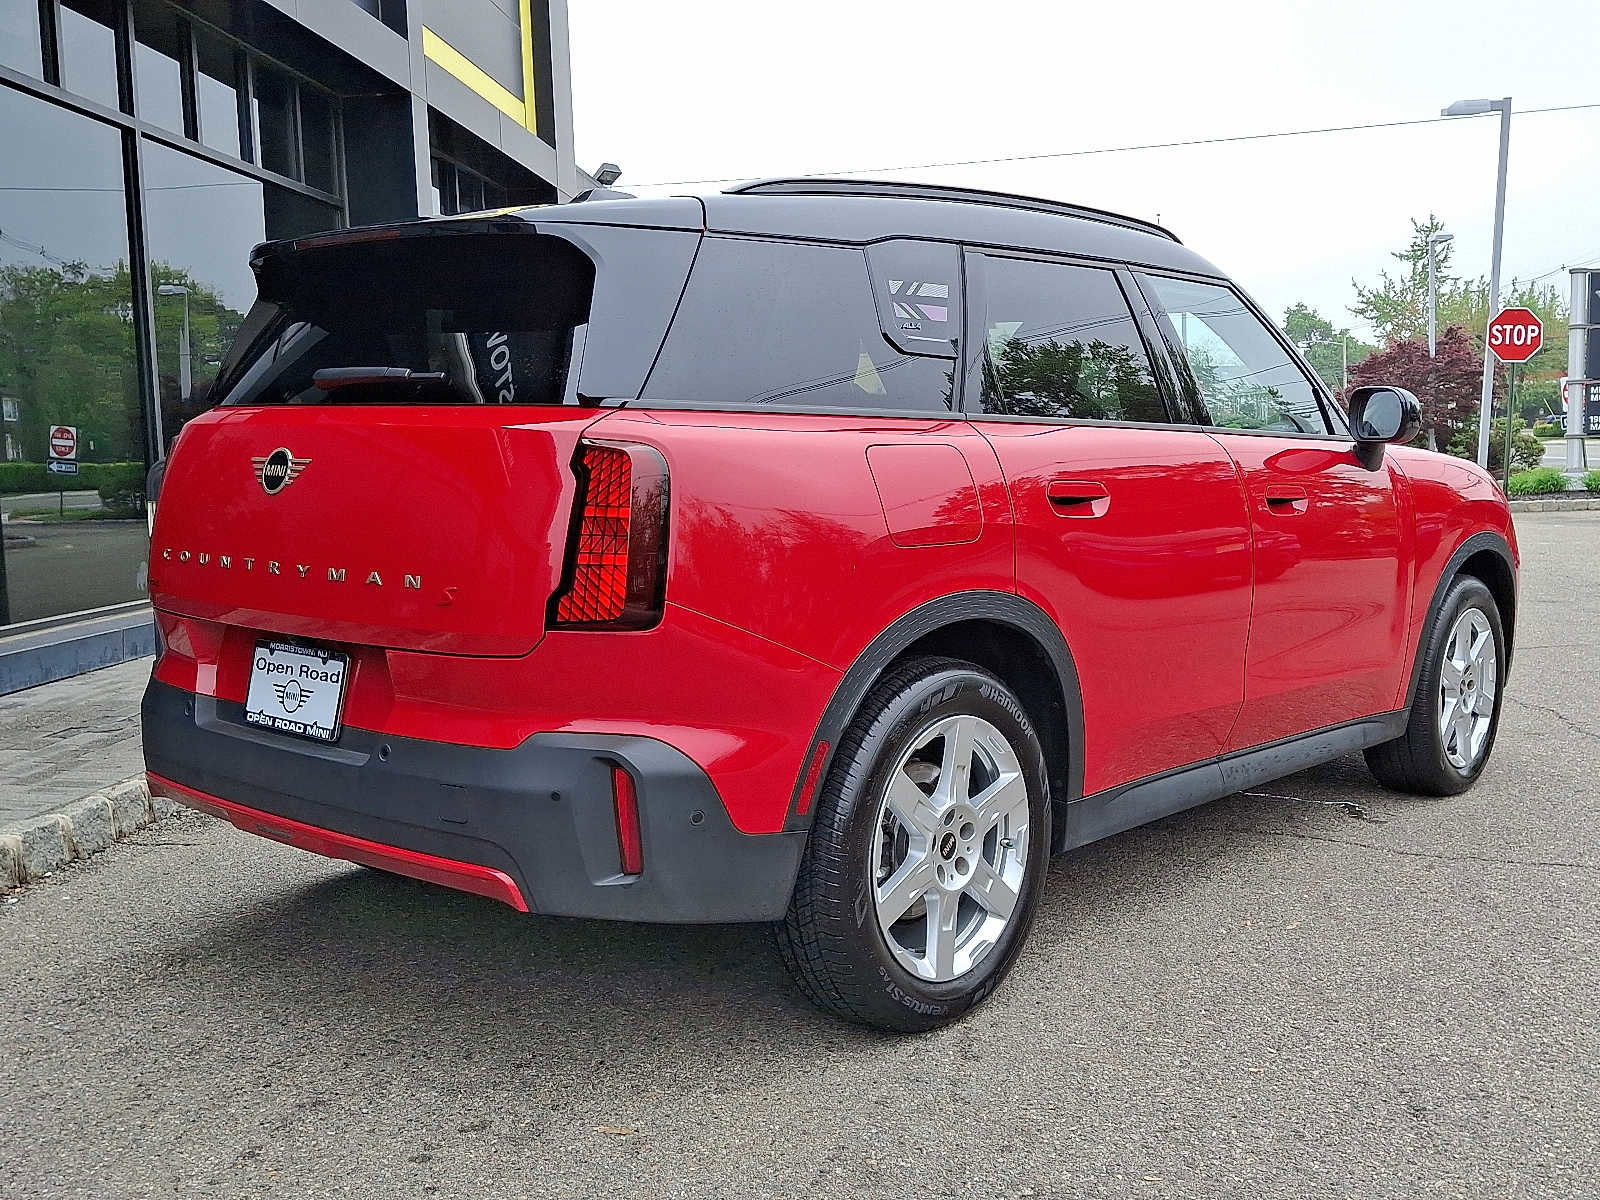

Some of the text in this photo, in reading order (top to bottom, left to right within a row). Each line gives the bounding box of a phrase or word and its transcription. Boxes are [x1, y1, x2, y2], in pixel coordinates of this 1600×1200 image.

[1491, 325, 1539, 345] STOP
[265, 464, 287, 477] MINI
[163, 548, 422, 589] COUNTRYMAN
[256, 657, 340, 683] Open Road
[285, 691, 299, 701] MINI
[247, 713, 330, 738] OPEN ROAD MINI
